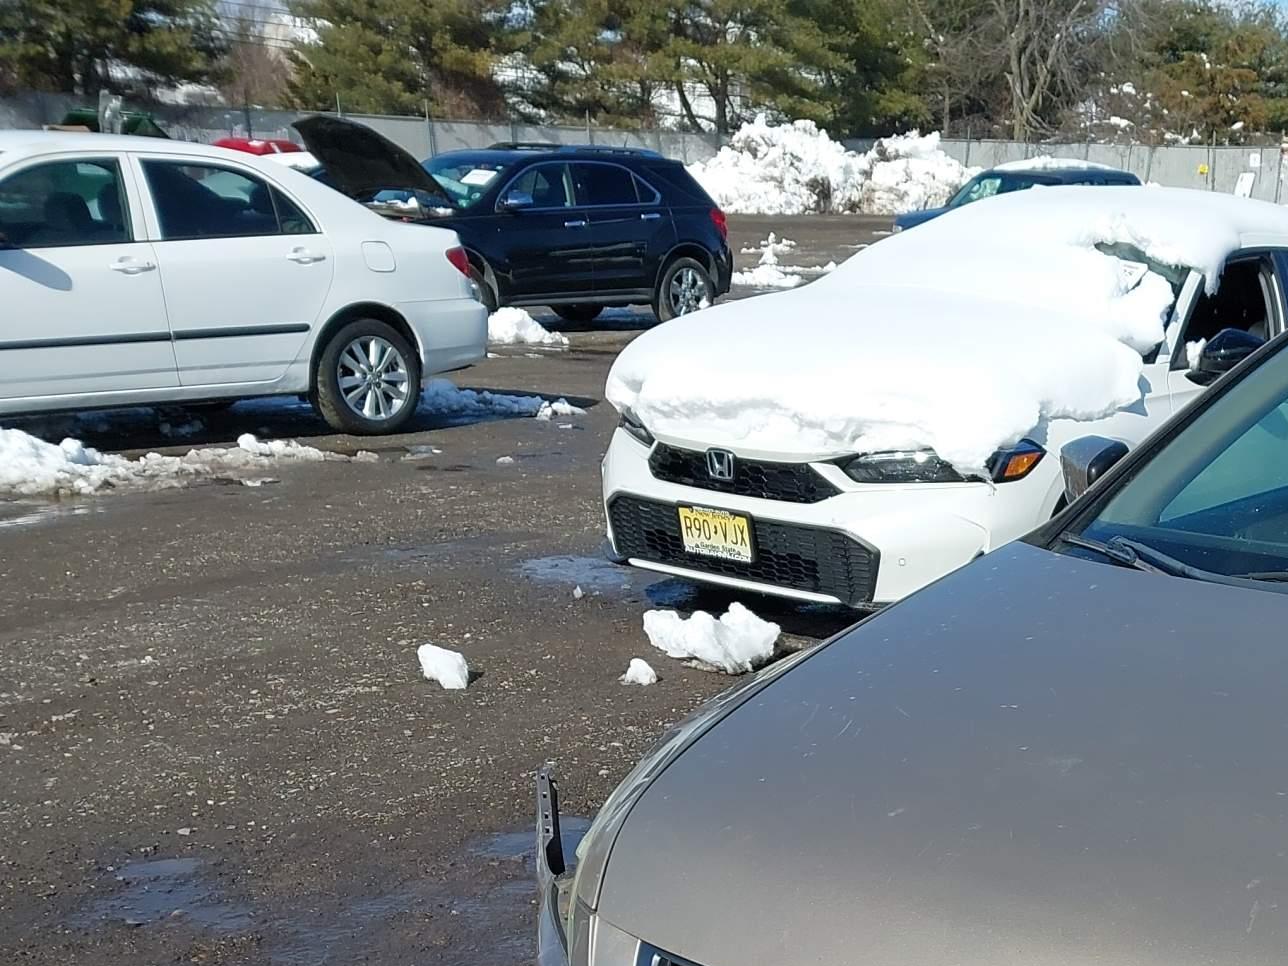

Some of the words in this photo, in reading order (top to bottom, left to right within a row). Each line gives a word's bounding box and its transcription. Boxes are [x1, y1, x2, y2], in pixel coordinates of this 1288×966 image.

[683, 515, 712, 541] R90
[699, 541, 720, 551] Garden
[721, 545, 737, 554] State
